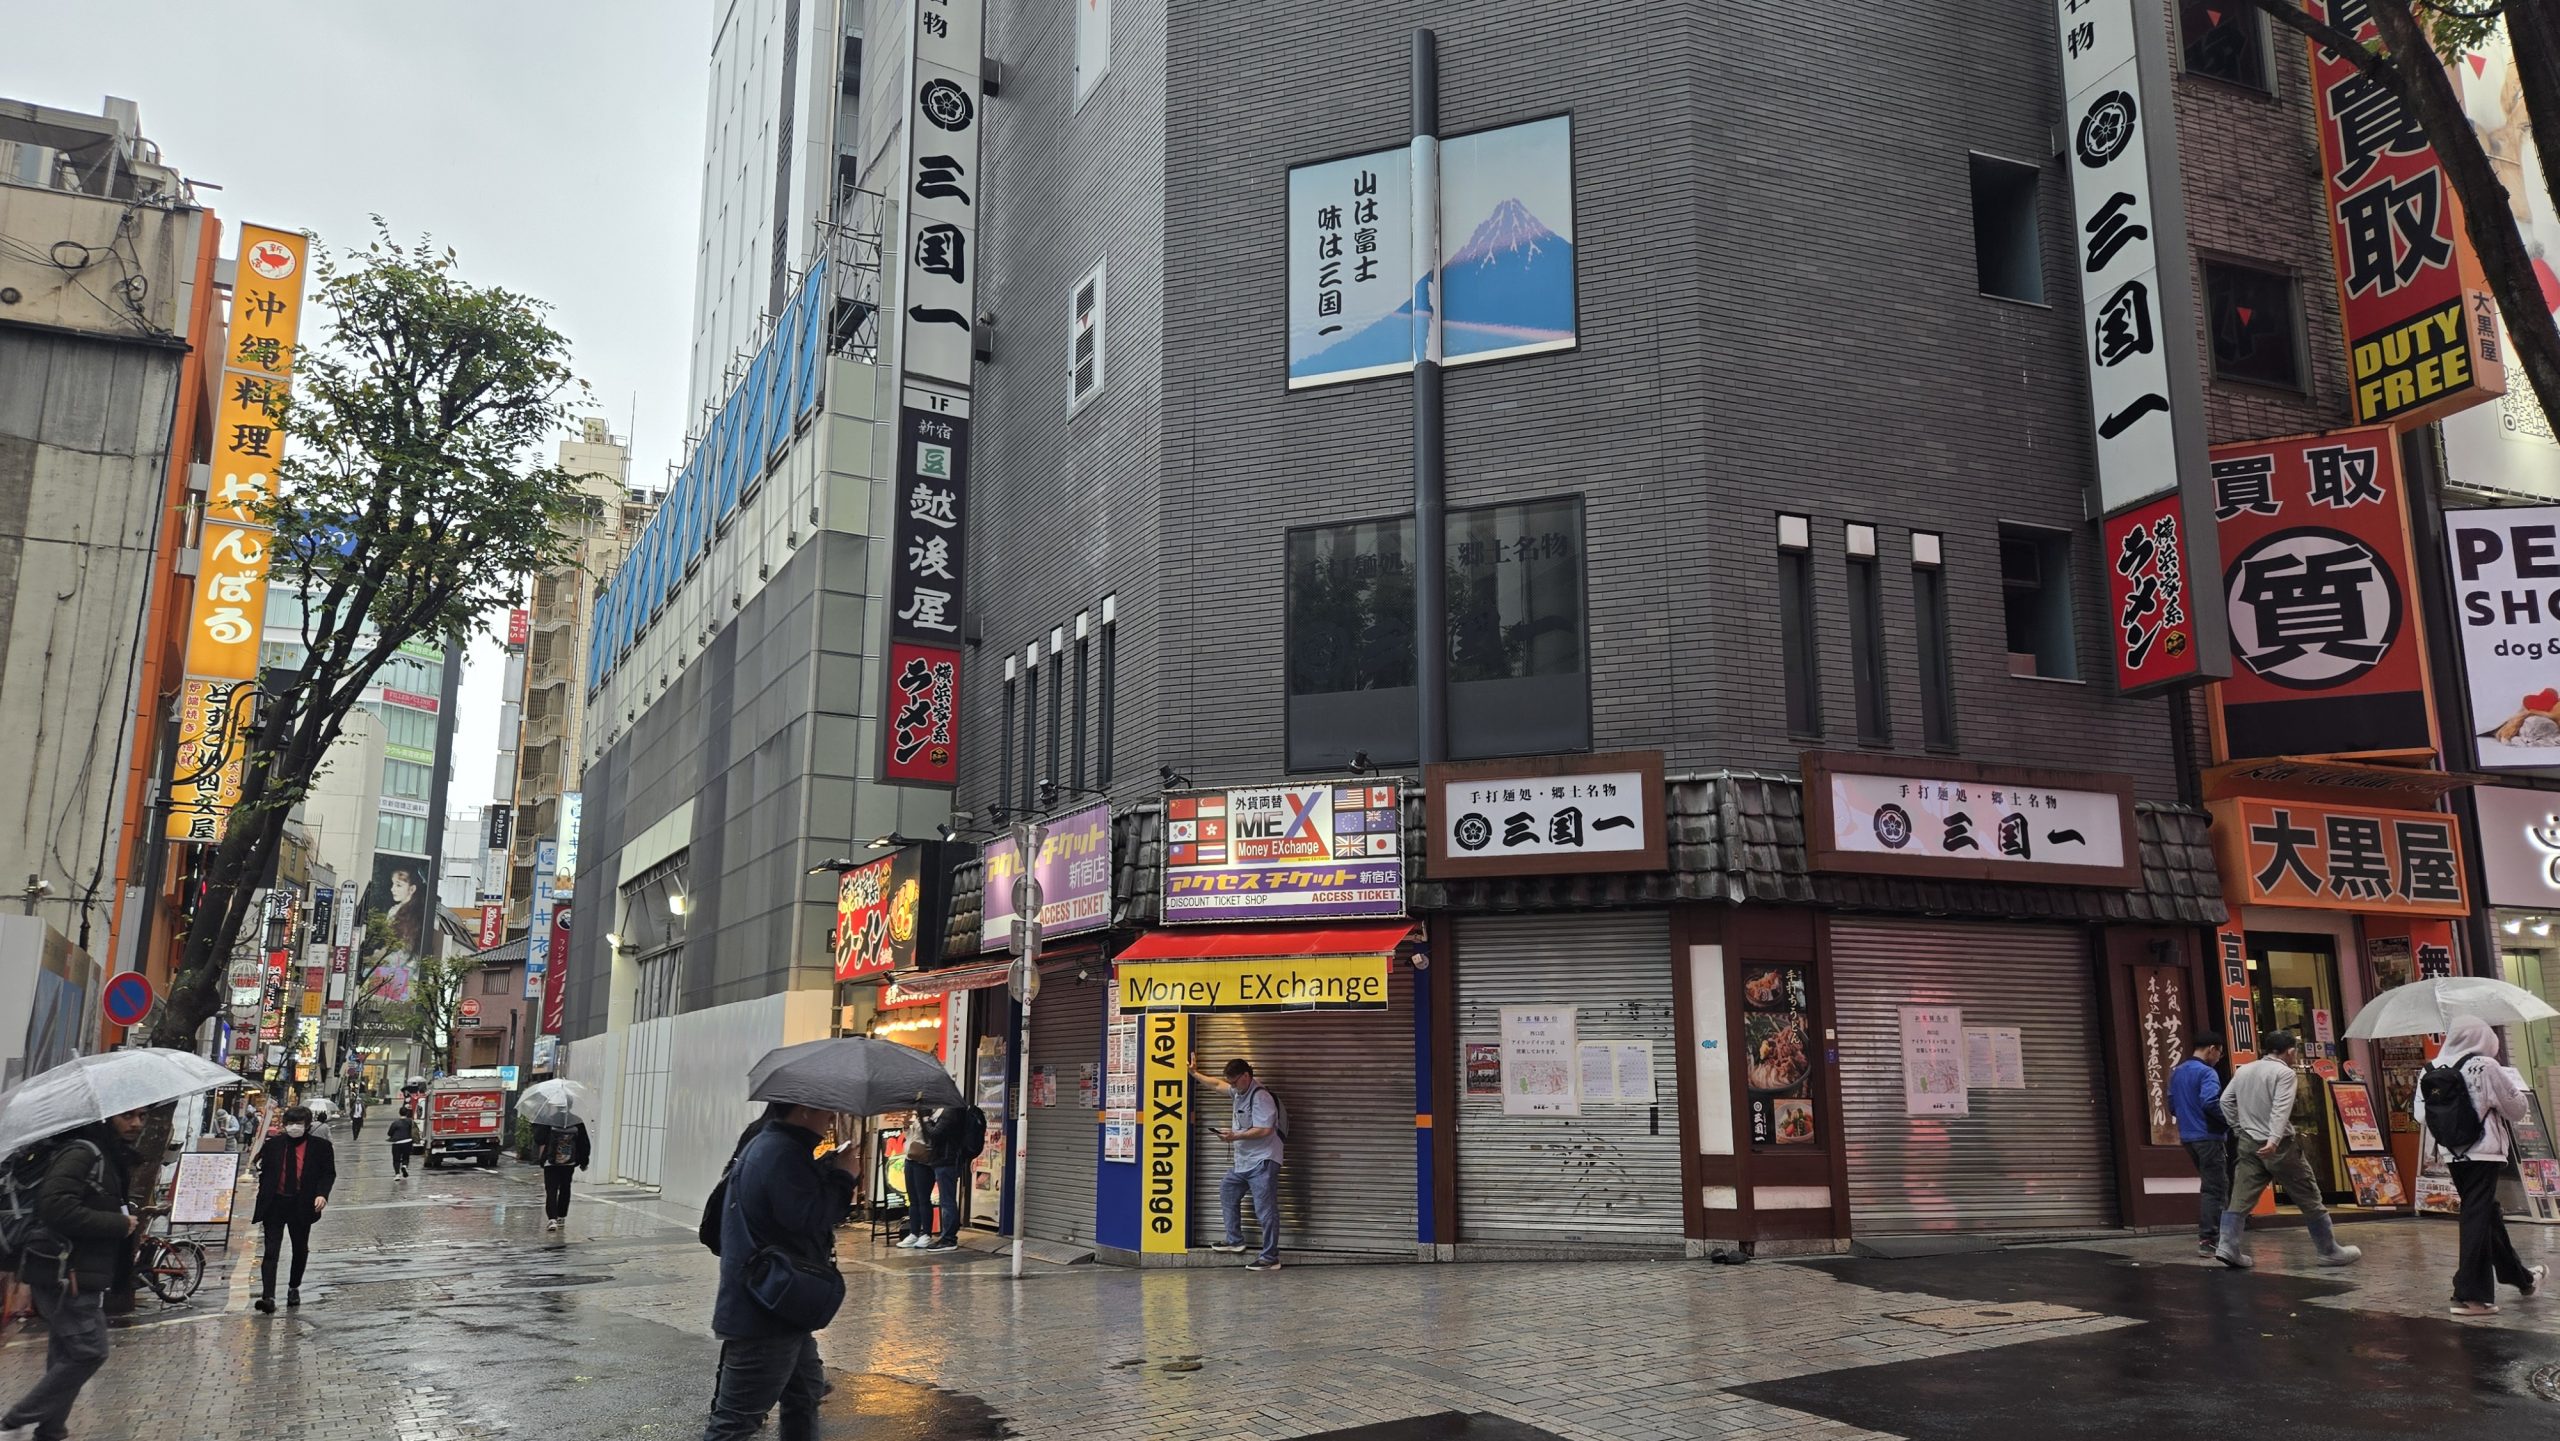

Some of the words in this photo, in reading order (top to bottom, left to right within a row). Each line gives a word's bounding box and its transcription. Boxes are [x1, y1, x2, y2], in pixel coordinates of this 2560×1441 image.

[923, 0, 948, 39] 物
[908, 154, 972, 333] 三国一
[1353, 169, 1379, 284] 山は富士
[1317, 204, 1343, 337] 味は三国一
[2085, 191, 2169, 440] 三国一
[2355, 303, 2462, 380] DUTY
[2472, 291, 2499, 363] 大黒屋
[227, 288, 288, 459] 沖縄料理
[929, 396, 950, 412] 1F
[2360, 346, 2469, 422] FREE
[917, 418, 953, 440] 新宿
[2210, 447, 2385, 523] 買取
[204, 472, 270, 644] やんばる
[898, 483, 957, 634] 越後屋
[2153, 514, 2184, 629] 横浜家系
[2455, 525, 2560, 581] PE
[2116, 523, 2163, 669] ラーメン
[2237, 544, 2389, 674] 質
[894, 657, 934, 765] ラーメン
[930, 661, 954, 744] 横浜家系
[1235, 796, 1283, 810] 外貨両替
[1235, 792, 1327, 848] MEX
[1502, 806, 1635, 847] 三国一
[1943, 811, 2086, 860] 三国一
[986, 823, 1105, 883] アクセチケット
[1068, 855, 1105, 889] 新宿店
[1237, 842, 1269, 857] Money
[1271, 840, 1319, 856] EXchange
[1360, 871, 1397, 884] 新宿店
[2250, 809, 2460, 903] 大黒屋
[532, 881, 553, 953] セキネ
[1040, 903, 1071, 925] ACCESS
[1072, 894, 1105, 917] TICKET
[1170, 897, 1210, 908] DISCOUNT
[1213, 896, 1241, 906] TICKET
[1245, 895, 1268, 905] SHOP
[1312, 892, 1354, 903] ACCESS
[1357, 890, 1396, 901] TICKET
[836, 910, 890, 974] ラーメン
[1129, 977, 1221, 1006] Money
[1239, 970, 1380, 1002] EXchange
[1785, 969, 1801, 1045] 手打ちうどん
[2217, 931, 2255, 1070] 高価
[951, 989, 966, 1085] 下にテー
[2344, 1107, 2367, 1117] SALE
[1149, 1079, 1183, 1234] EXchange
